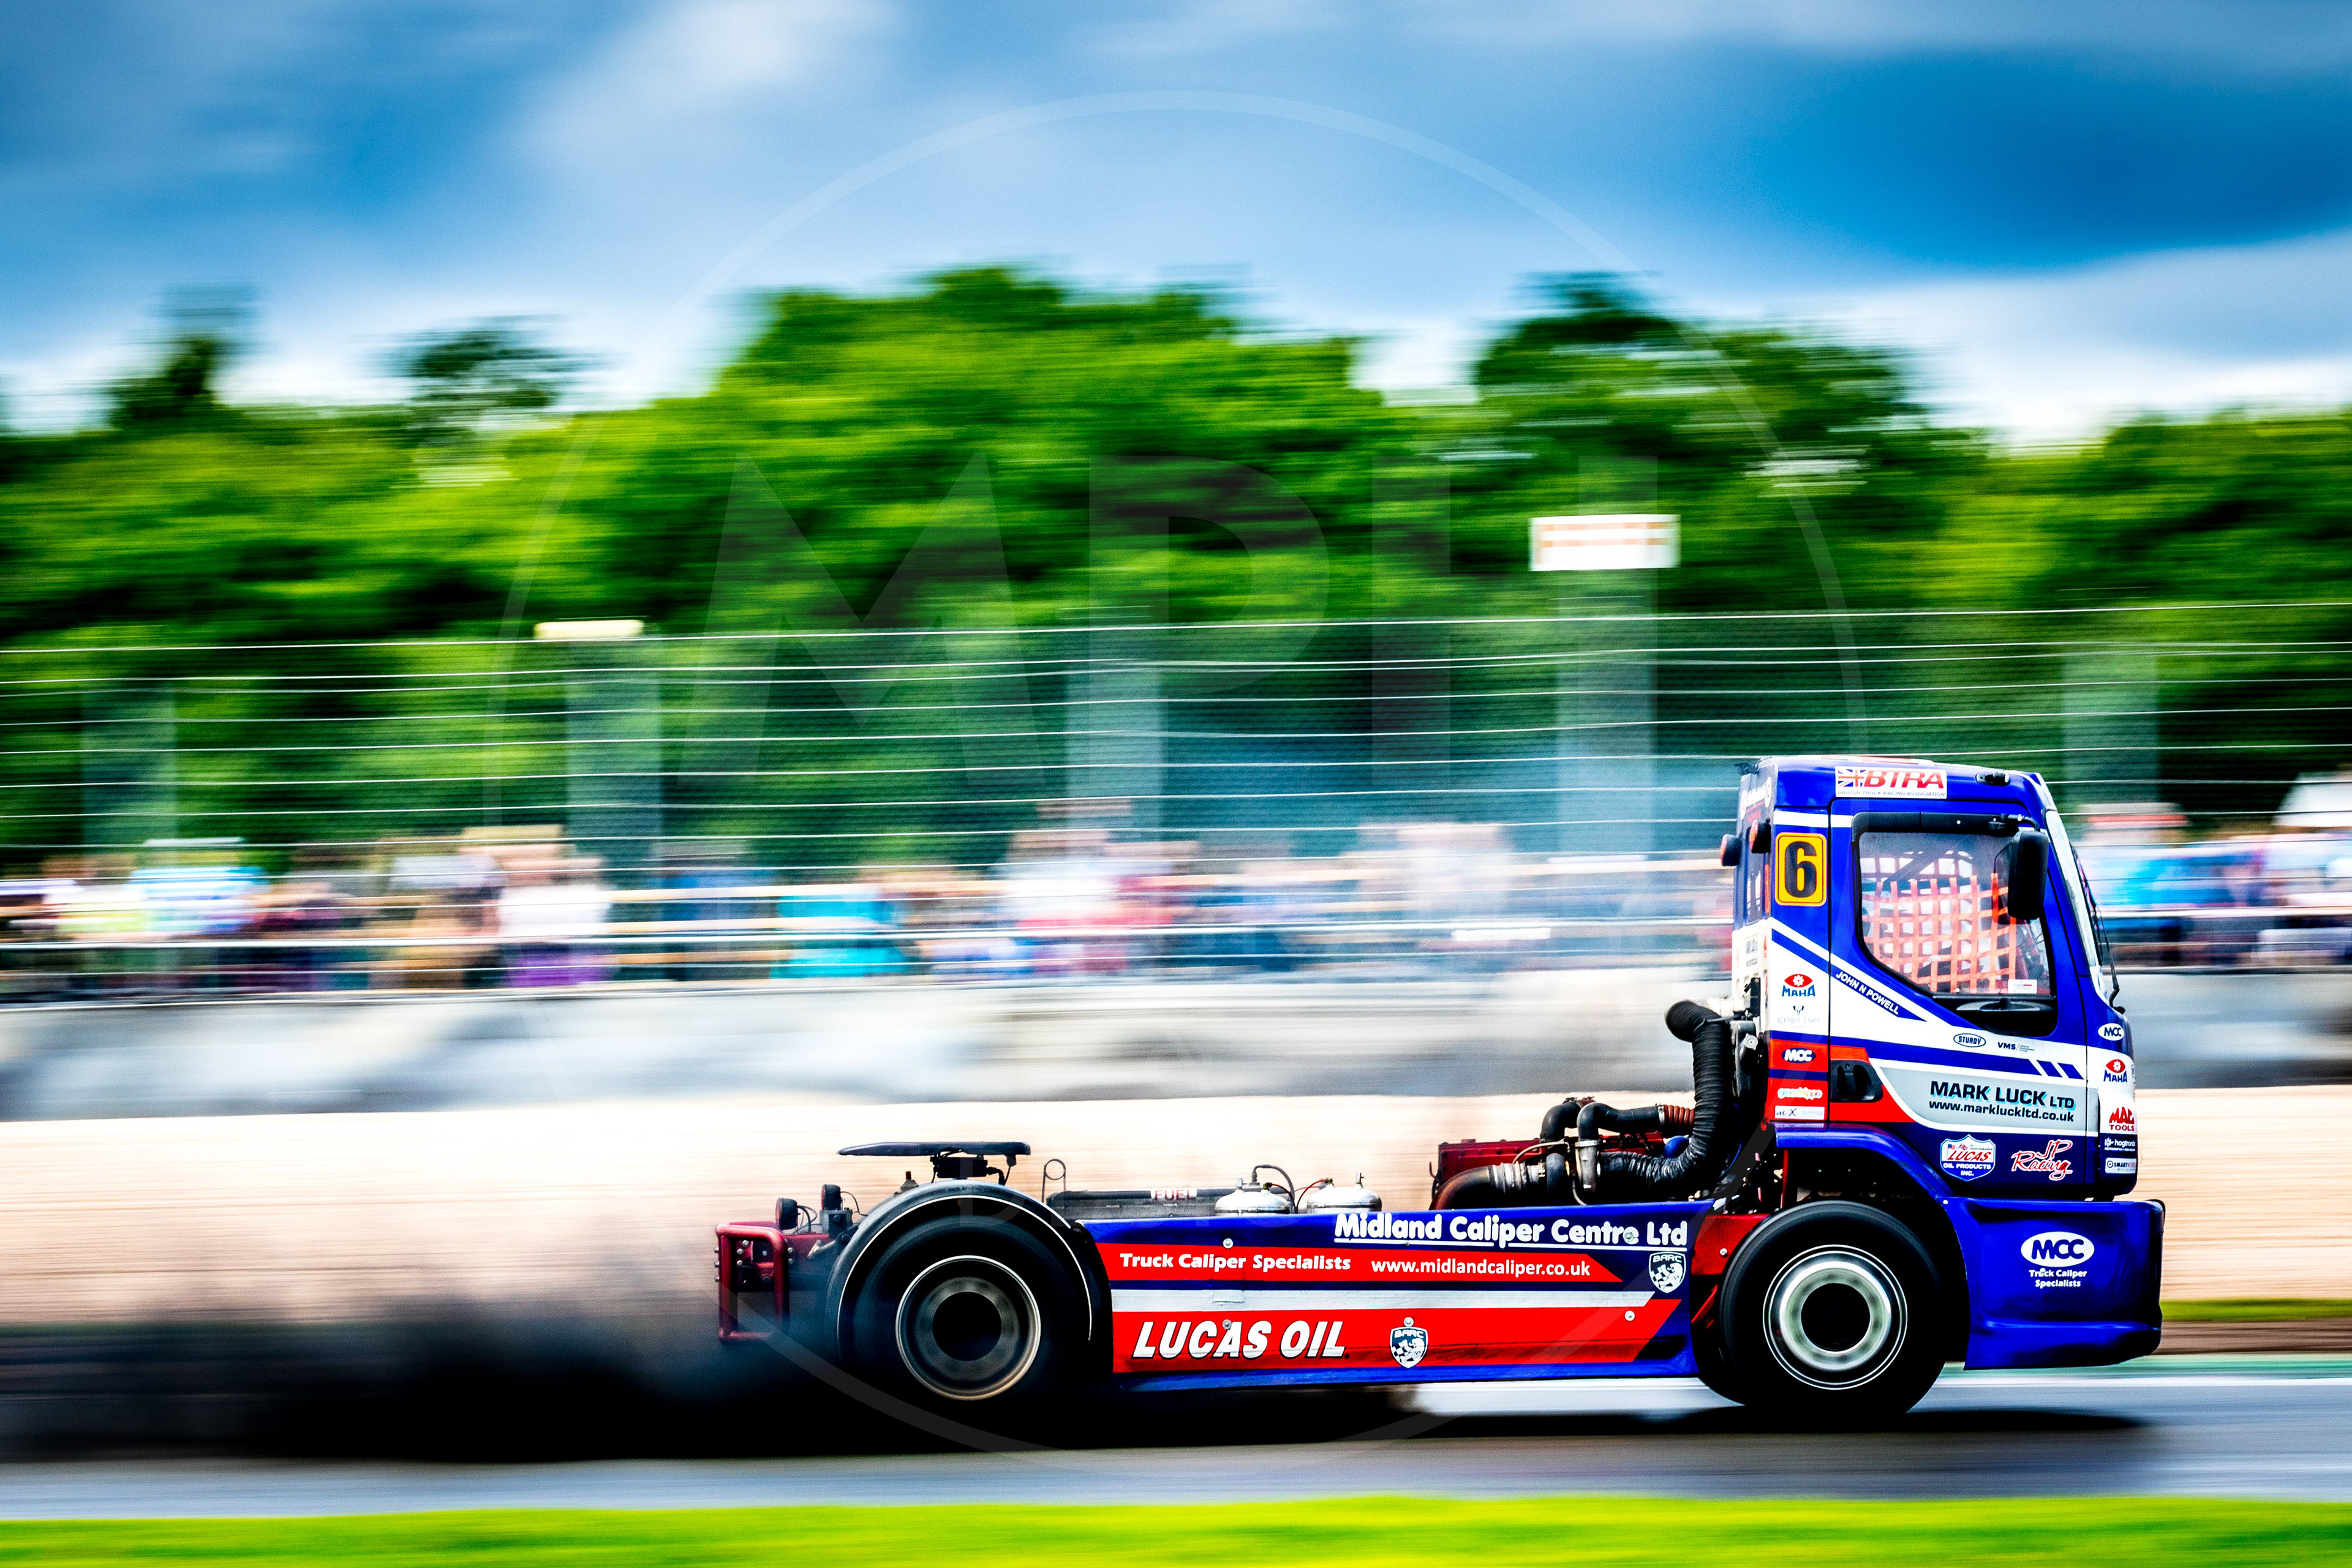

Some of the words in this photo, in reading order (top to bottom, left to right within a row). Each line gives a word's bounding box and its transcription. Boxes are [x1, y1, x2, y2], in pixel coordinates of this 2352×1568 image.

[1863, 770, 1944, 788] BTRA
[1785, 841, 1817, 898] 6
[1782, 984, 1815, 997] MAHA
[1836, 971, 1860, 989] JOHN
[1858, 984, 1867, 993] N
[1866, 989, 1898, 1015] POWELL
[1958, 1036, 1981, 1045] STURDY
[2104, 1027, 2122, 1036] MCC
[1784, 1049, 1812, 1061] MCC
[2103, 1069, 2127, 1082] MAHA
[1930, 1081, 1990, 1101] MARK
[1996, 1087, 2046, 1106] LUCK
[2050, 1096, 2075, 1109] LTD
[1929, 1101, 2074, 1122] www.markluckltd.co.uk
[2109, 1107, 2135, 1124] MAC
[1947, 1150, 1992, 1161] LUCAS
[2037, 1139, 2073, 1159] JP
[2011, 1150, 2073, 1181] Racing
[1155, 1189, 1196, 1200] FUEL
[1335, 1212, 1442, 1239] Midland
[1449, 1215, 1545, 1249] Caliper
[1551, 1219, 1639, 1245] Centre
[1647, 1221, 1687, 1246] Ltd
[2032, 1239, 2084, 1259] MCC
[1120, 1253, 1174, 1268] Truck
[1178, 1254, 1246, 1272] Caliper
[1253, 1254, 1351, 1272] Specialists
[1371, 1258, 1591, 1278] www.midlandcaliper.co.uk
[2056, 1269, 2087, 1279] Caliper
[2035, 1280, 2081, 1289] Specialists
[1133, 1320, 1272, 1359] LUCAS
[1280, 1320, 1346, 1359] OIL
[1394, 1329, 1424, 1338] BARC
